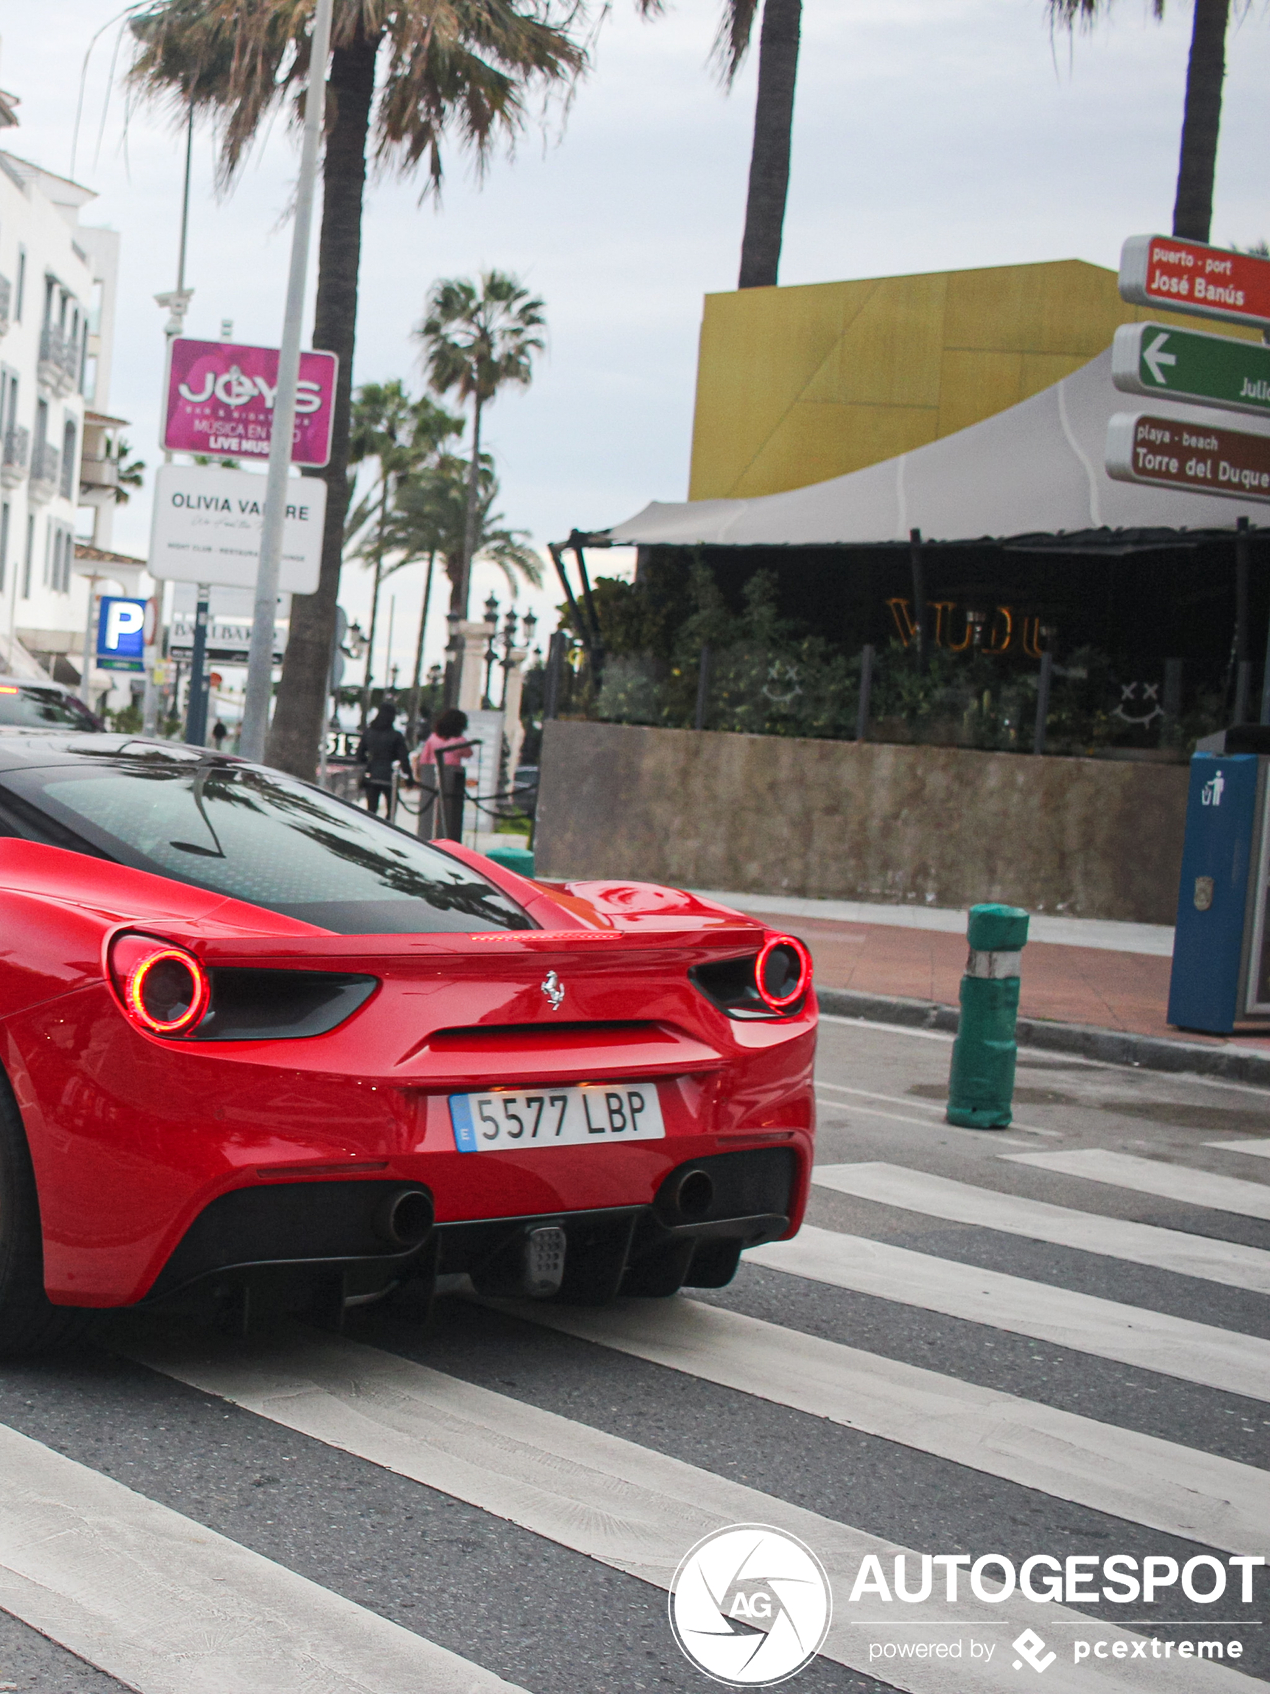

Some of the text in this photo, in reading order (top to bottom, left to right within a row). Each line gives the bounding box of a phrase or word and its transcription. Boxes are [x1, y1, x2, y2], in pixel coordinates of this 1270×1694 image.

[1153, 248, 1194, 267] puerto
[1205, 259, 1233, 275] port
[1151, 269, 1245, 306] José Banús
[209, 435, 240, 451] LIVE
[248, 424, 267, 440] EN
[1137, 425, 1170, 445] playa
[1182, 432, 1218, 450] beach
[1136, 448, 1270, 489] Torre del Duque
[171, 493, 310, 521] OLIVIA VARE
[105, 602, 144, 650] P
[477, 1091, 645, 1141] 5577 LBP
[460, 1128, 471, 1141] E
